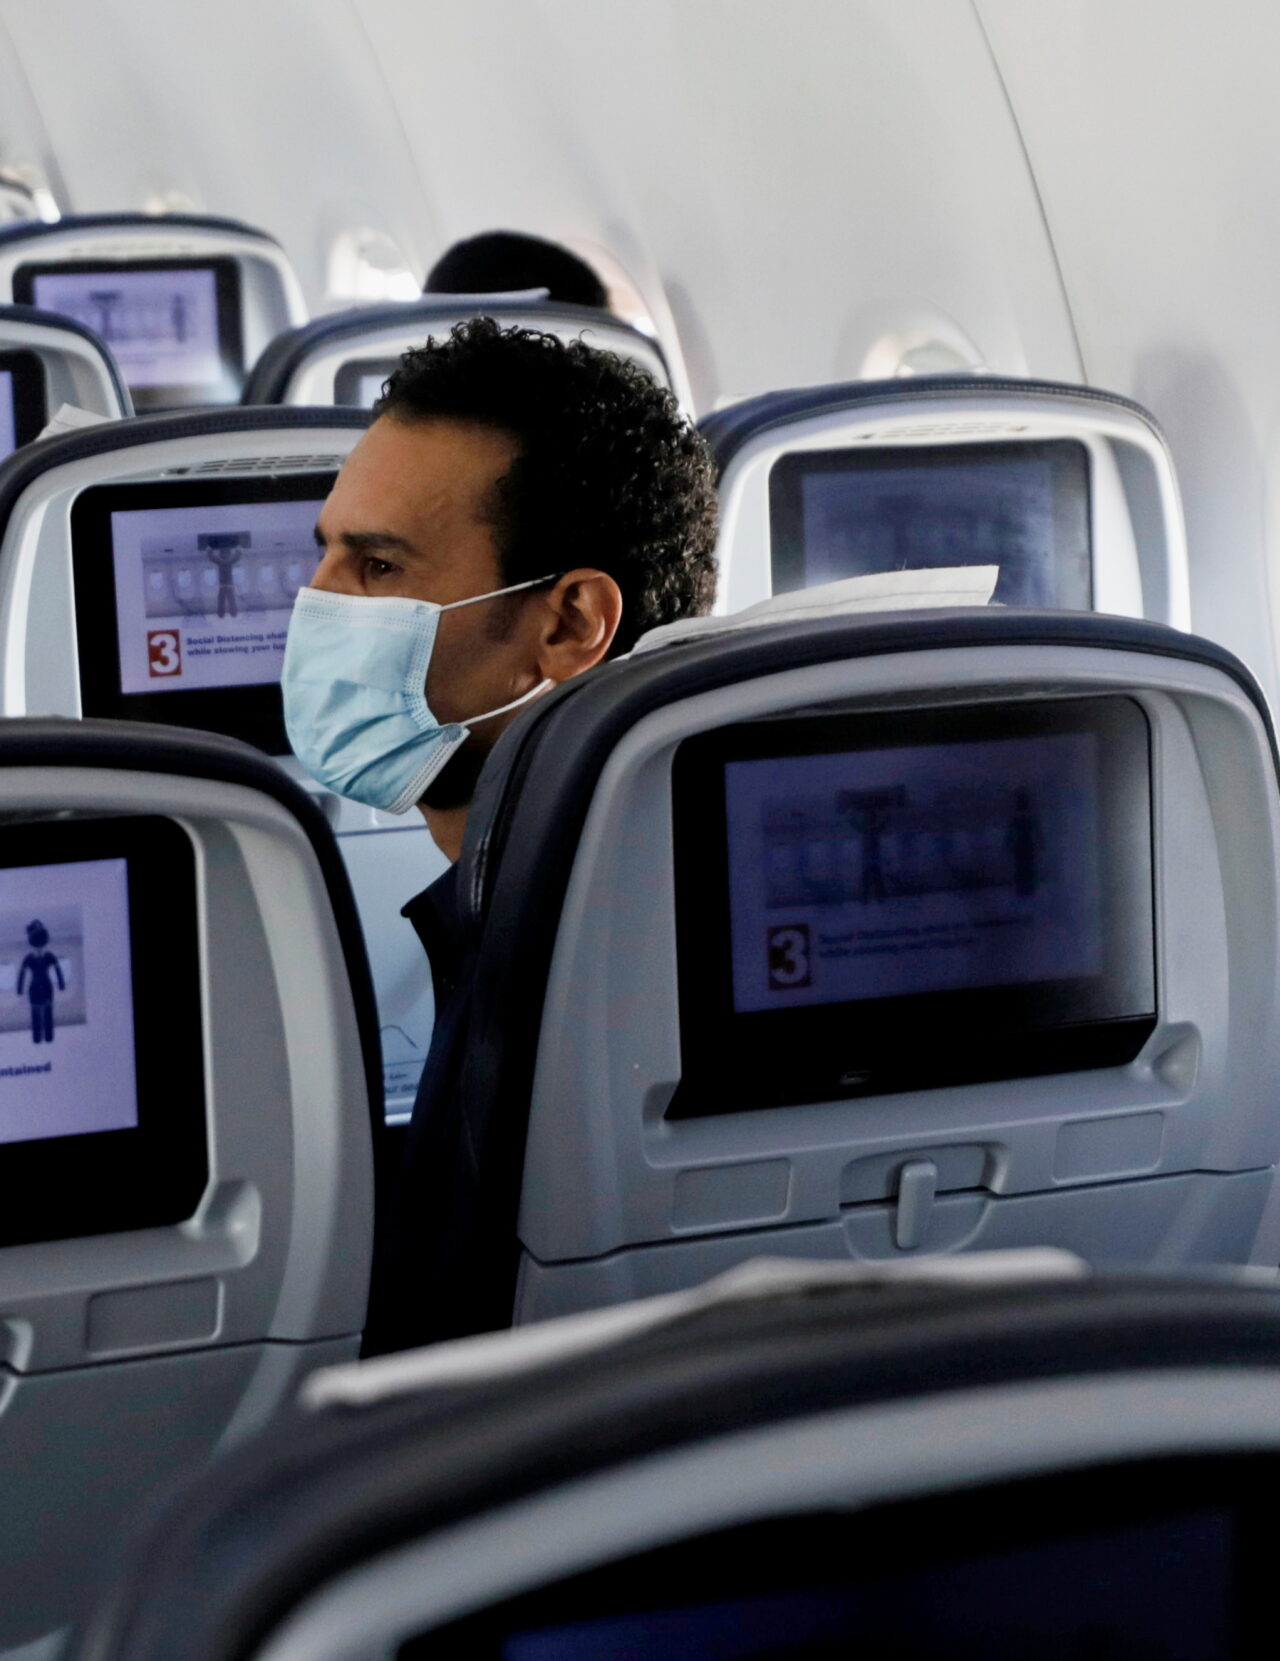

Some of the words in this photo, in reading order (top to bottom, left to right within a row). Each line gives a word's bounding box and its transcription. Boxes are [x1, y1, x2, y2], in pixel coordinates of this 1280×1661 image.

[150, 633, 179, 673] 3
[187, 637, 215, 646] Social
[770, 929, 808, 984] 3
